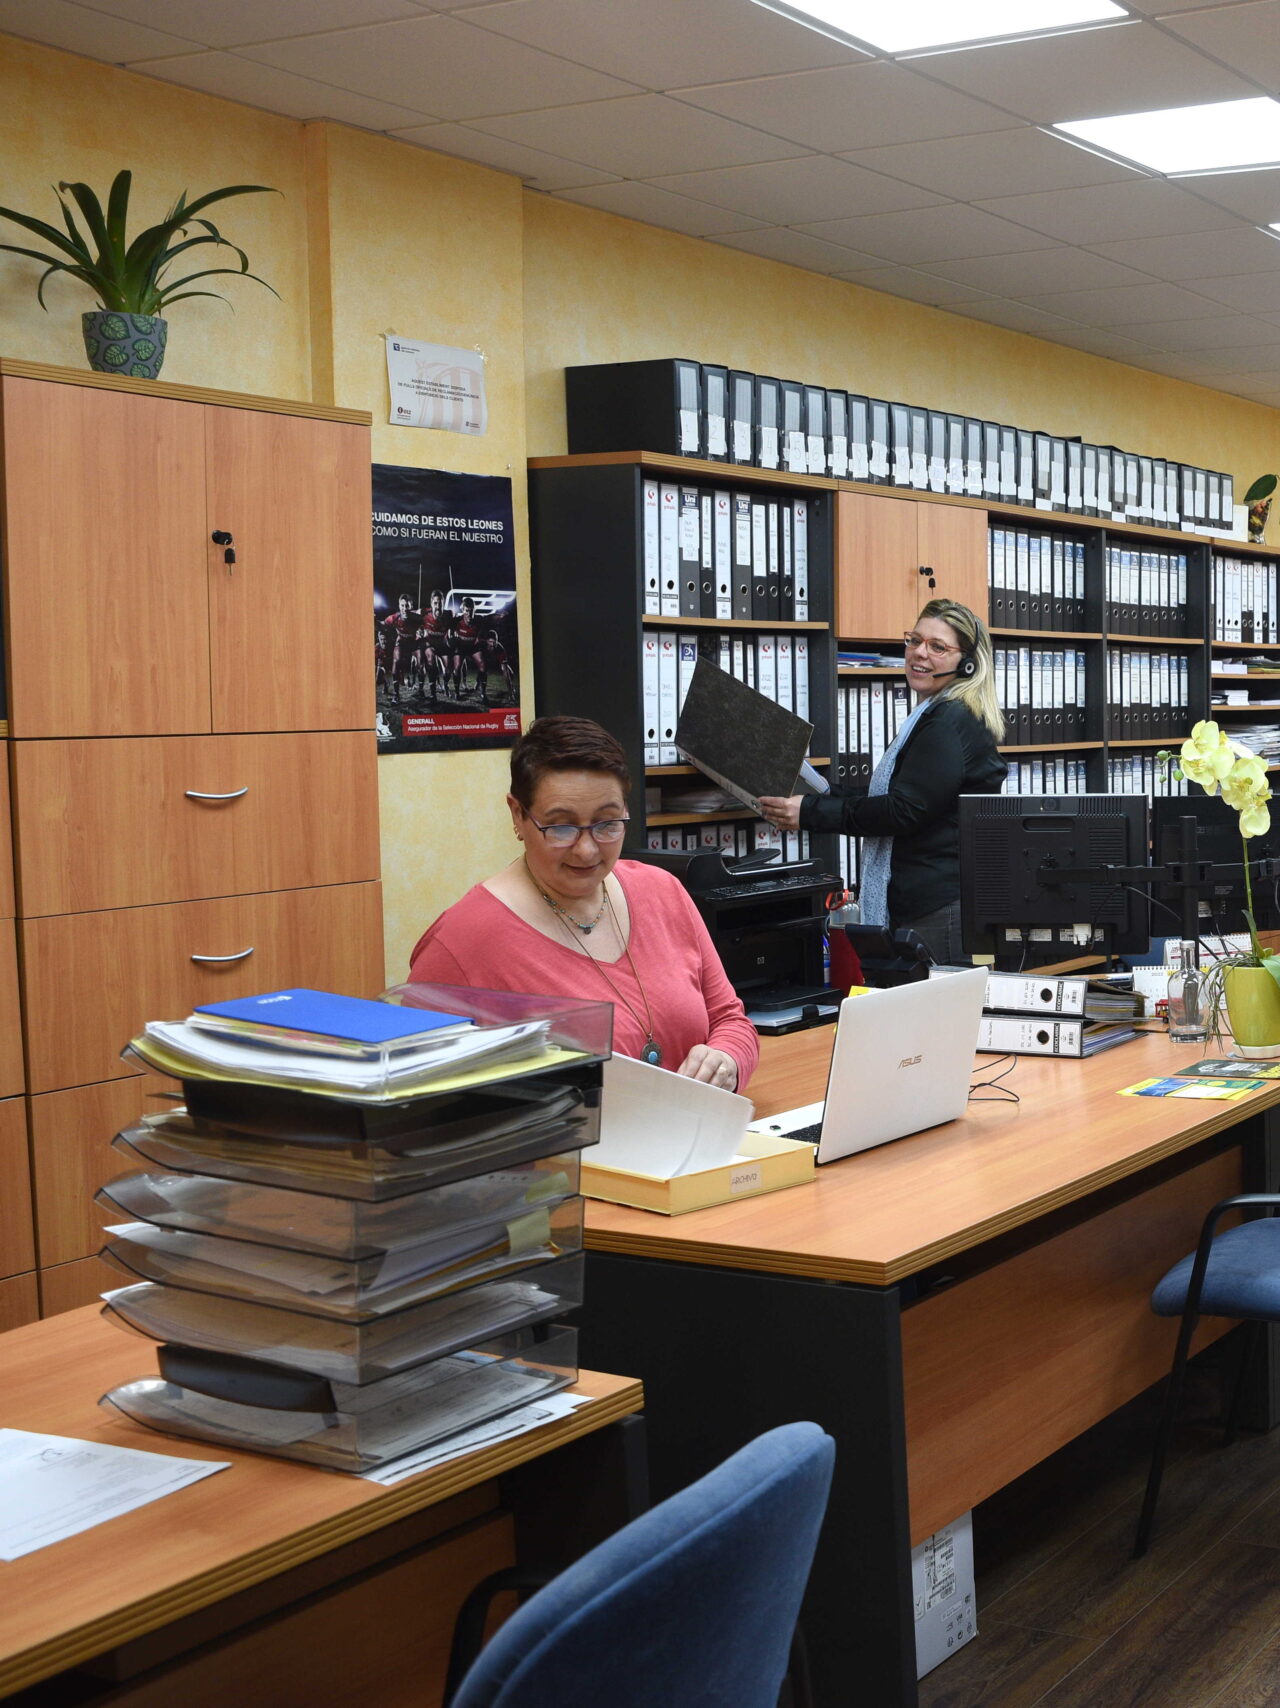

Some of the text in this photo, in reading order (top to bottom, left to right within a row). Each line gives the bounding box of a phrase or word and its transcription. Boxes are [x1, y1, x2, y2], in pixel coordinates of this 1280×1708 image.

[421, 516, 435, 526] DE
[436, 517, 467, 528] ESTOS
[468, 519, 504, 531] LEONES
[400, 527, 409, 538] SI
[411, 528, 448, 540] FUERAN
[449, 531, 460, 541] EL
[462, 533, 504, 544] NUESTRO
[897, 1054, 922, 1069] ASUS
